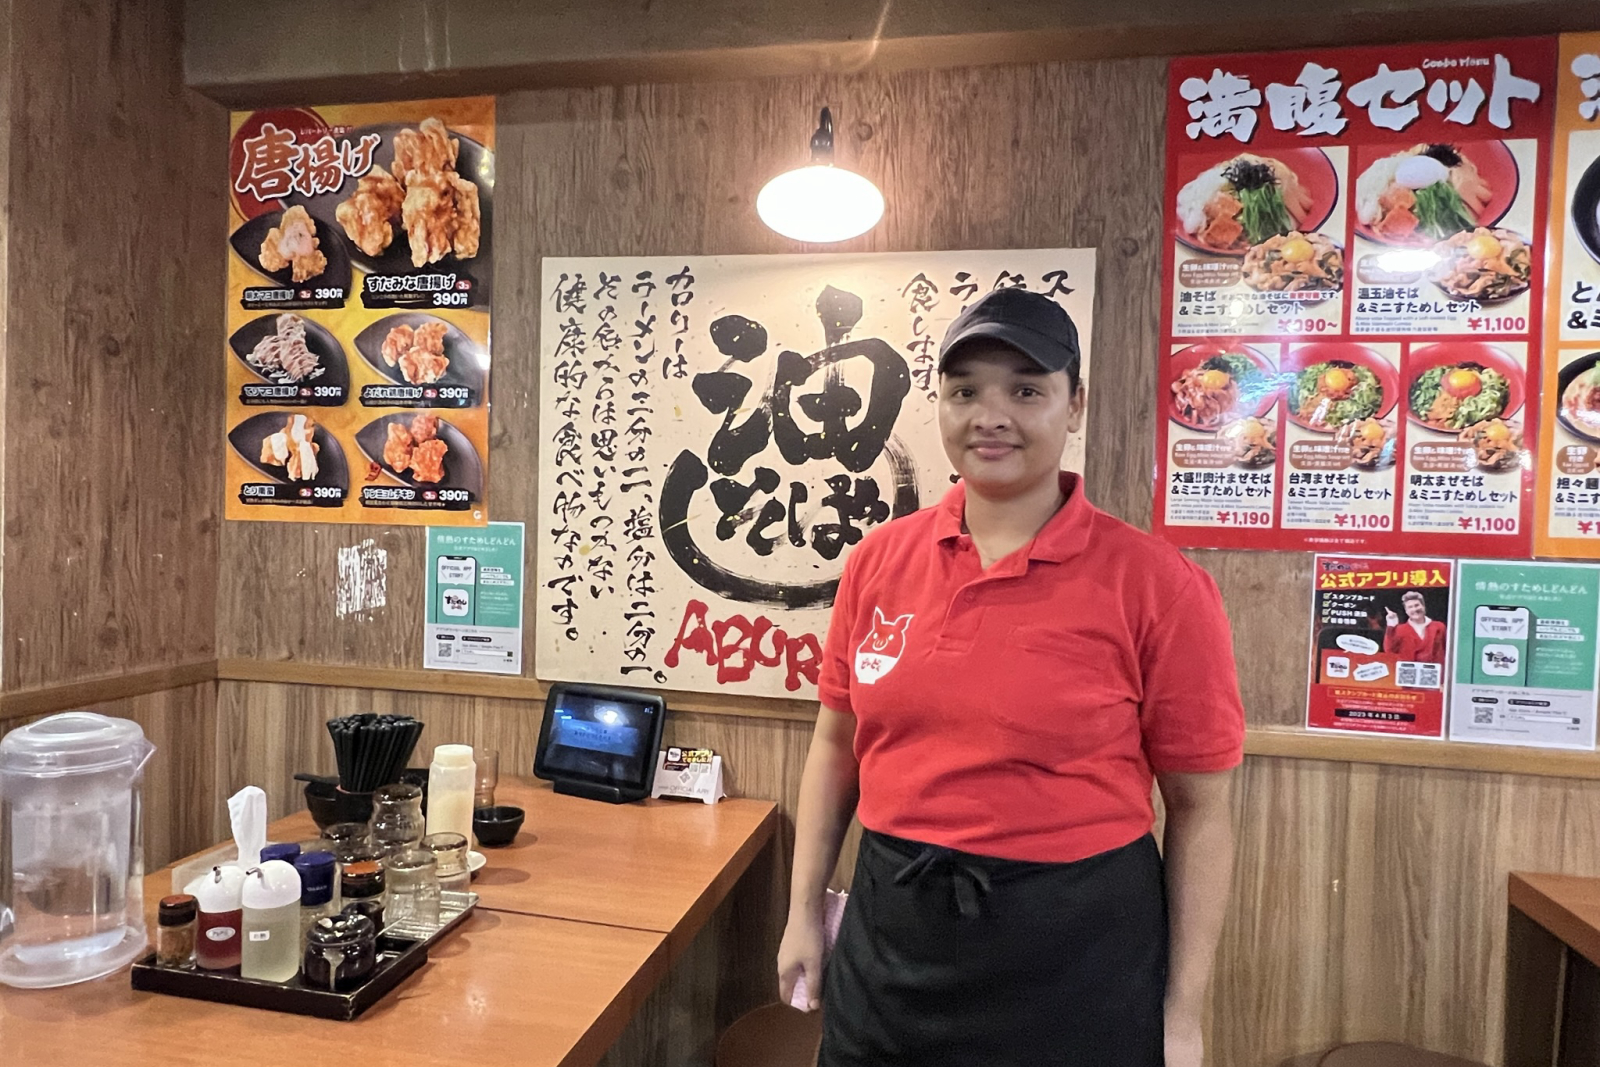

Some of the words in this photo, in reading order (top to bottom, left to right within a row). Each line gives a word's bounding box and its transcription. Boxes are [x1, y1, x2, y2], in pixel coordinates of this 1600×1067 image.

[1179, 54, 1541, 142] 満腹セット
[235, 123, 381, 202] 唐揚げ
[367, 274, 457, 292] すたみな唐揚げ
[1180, 291, 1216, 303] 油そば
[1358, 287, 1419, 300] 温玉油そば
[1356, 301, 1480, 314] &ミニすためしセット
[663, 265, 695, 380] カロリーは
[1468, 317, 1526, 332] ¥1,100
[901, 272, 941, 403] 食します。
[693, 284, 911, 476] 油
[1289, 473, 1360, 485] 台湾まぜそば
[1410, 475, 1484, 487] 明太まぜそば
[1171, 485, 1272, 497] &ミニすためしセット
[1288, 487, 1392, 500] &ミニすためしセット
[1409, 490, 1518, 502] &ミニすためしセット
[1217, 511, 1270, 525] ¥1,190
[1334, 514, 1390, 528] ¥1,100
[1458, 517, 1516, 531] ¥1,100
[1320, 570, 1447, 588] 公式アプリ導入
[1475, 581, 1588, 595] 情熱のすためしどんどん
